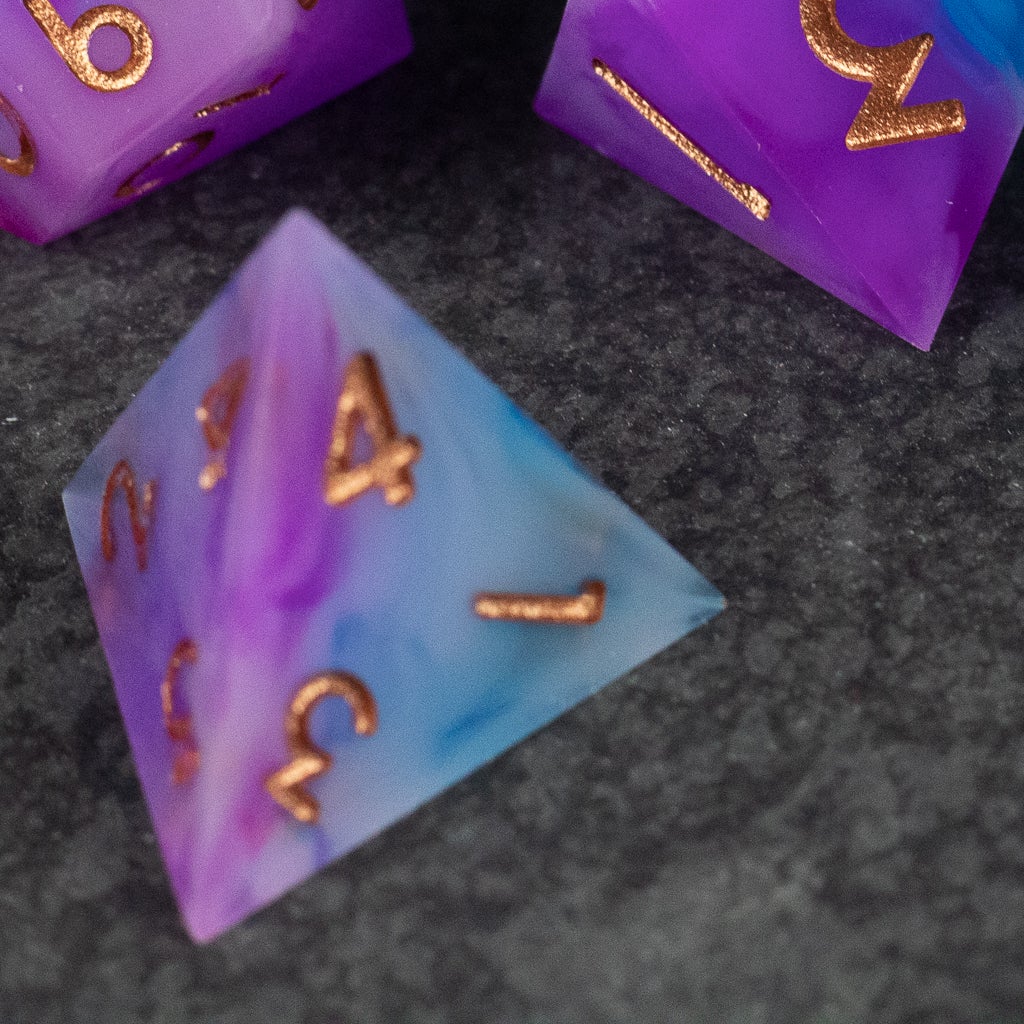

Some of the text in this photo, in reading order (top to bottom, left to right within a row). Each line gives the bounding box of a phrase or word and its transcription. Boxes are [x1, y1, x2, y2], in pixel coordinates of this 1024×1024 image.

[591, 57, 772, 222] 1
[324, 349, 424, 507] 4
[472, 580, 607, 626] 1
